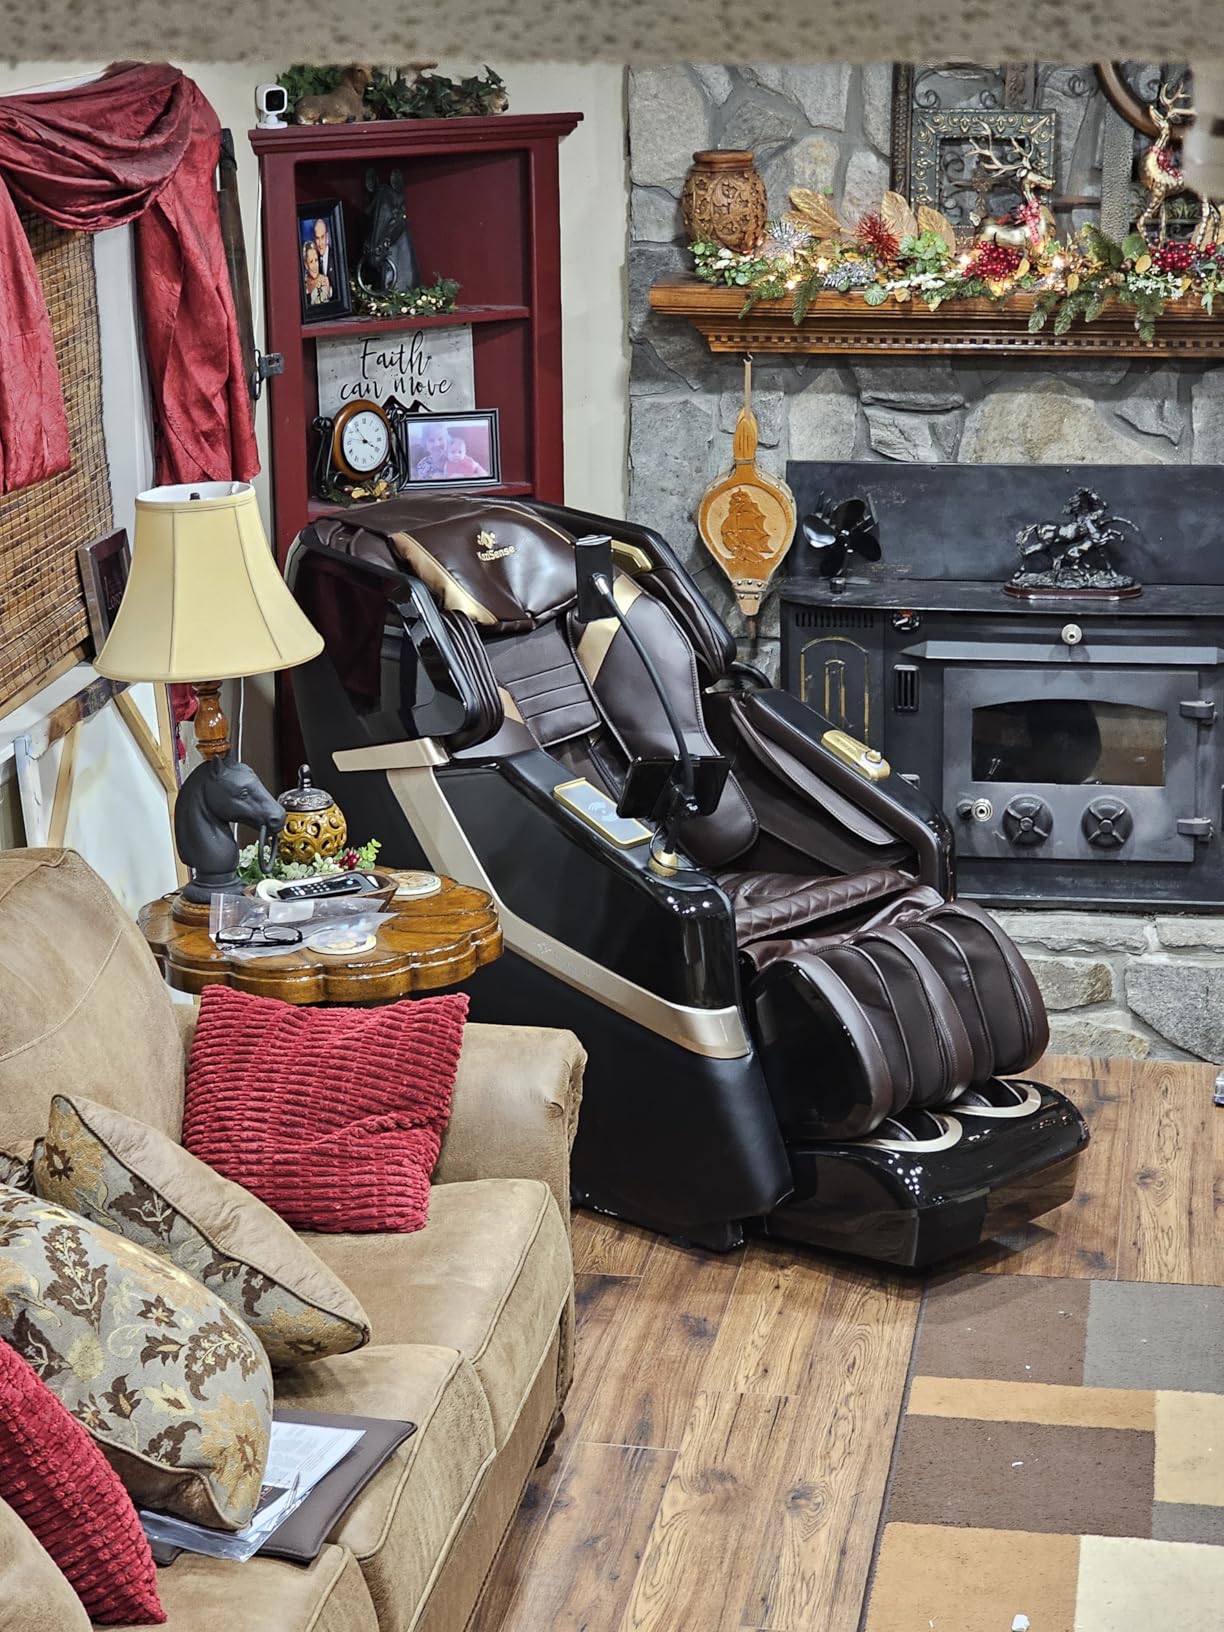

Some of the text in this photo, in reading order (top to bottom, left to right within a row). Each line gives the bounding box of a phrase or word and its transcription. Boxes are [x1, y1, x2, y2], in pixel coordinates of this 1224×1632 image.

[359, 331, 432, 379] Faith
[340, 376, 452, 400] can move
